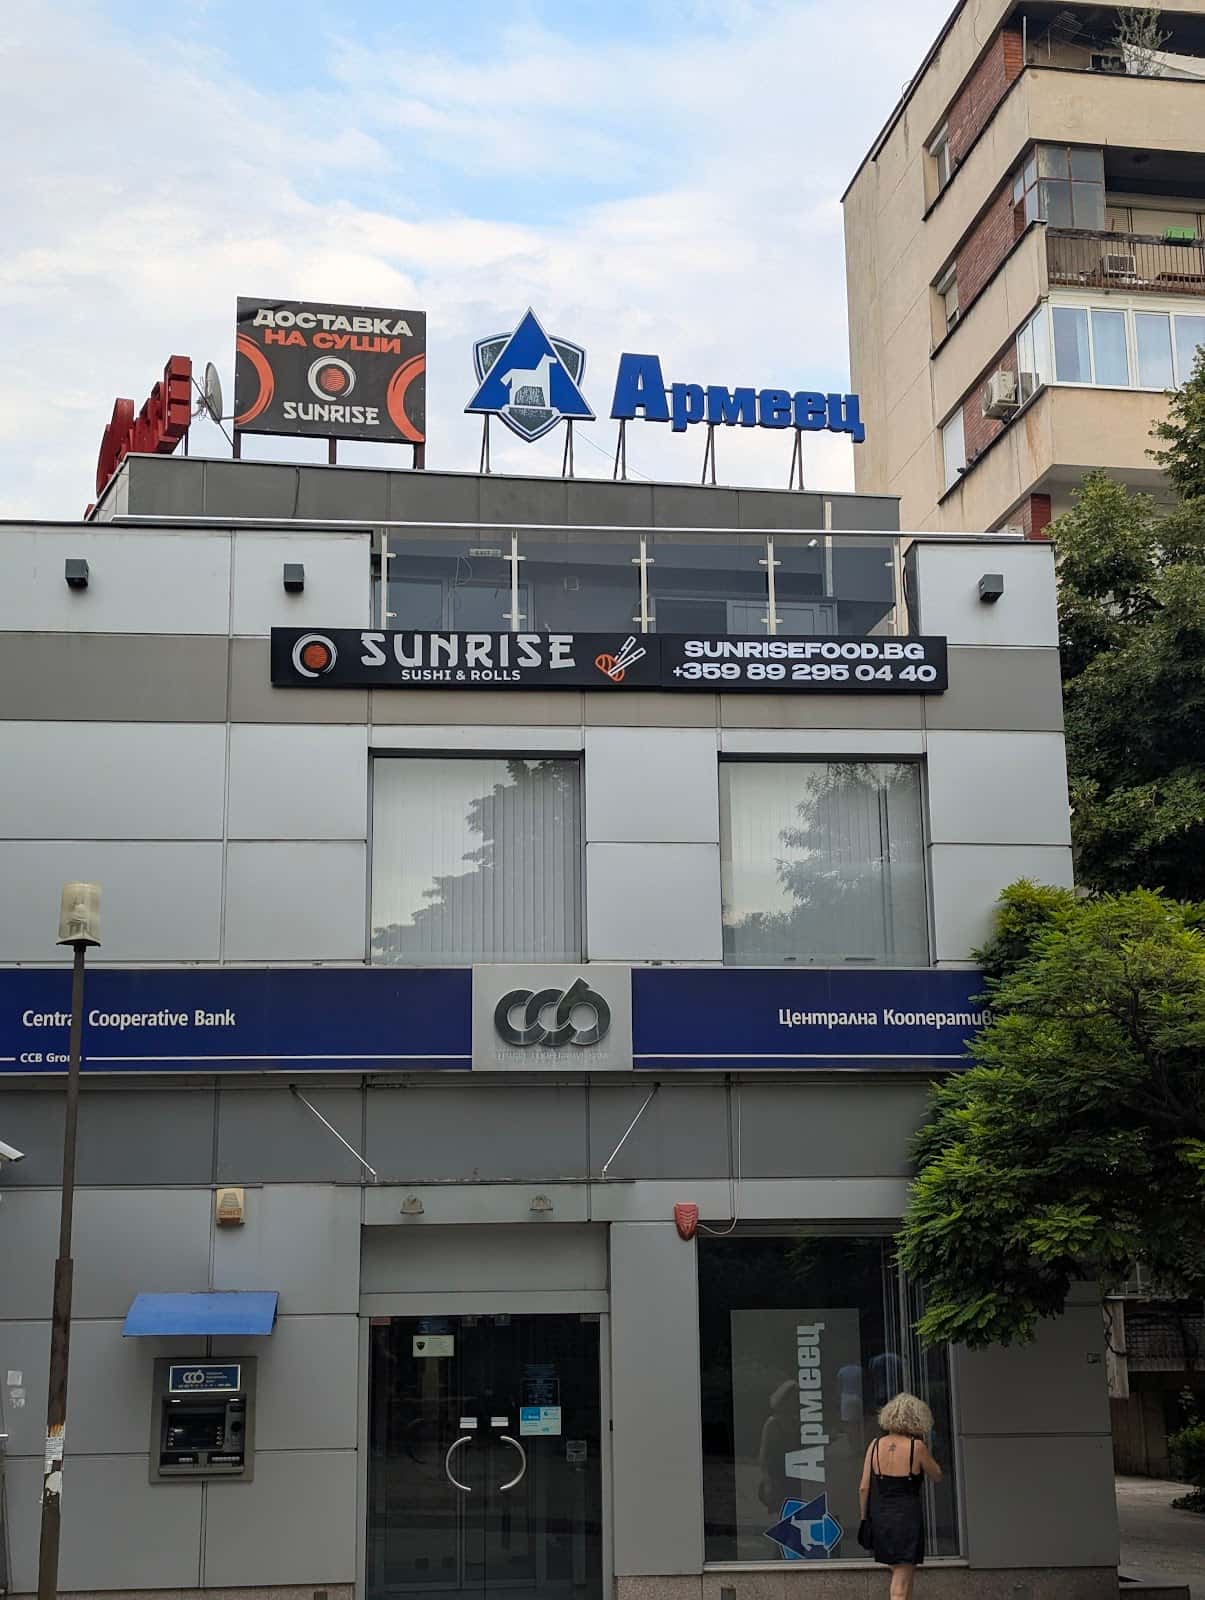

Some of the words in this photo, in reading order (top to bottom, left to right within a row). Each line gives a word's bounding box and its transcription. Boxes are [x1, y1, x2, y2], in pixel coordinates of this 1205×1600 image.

[253, 309, 413, 337] ДОСТАВКА
[264, 328, 307, 347] НА
[312, 332, 401, 354] СУШИ
[610, 352, 865, 443] Армеец
[283, 401, 380, 425] SUNRISE
[360, 632, 576, 669] SUNRISE
[684, 640, 925, 660] SUNRISEFOOD.BG
[401, 669, 451, 681] SUSHI
[455, 669, 466, 681] &
[471, 669, 521, 681] ROLLS
[672, 662, 741, 680] +359
[746, 663, 786, 680] 89
[791, 663, 850, 681] 295
[855, 664, 893, 681] 04
[899, 664, 937, 682] 40
[88, 1009, 188, 1030] Cooperative
[194, 1009, 236, 1027] Bank
[778, 1008, 877, 1029] Централна
[883, 1008, 996, 1029] Кооператив
[20, 1052, 43, 1063] CCB
[785, 1322, 830, 1483] Армеец
